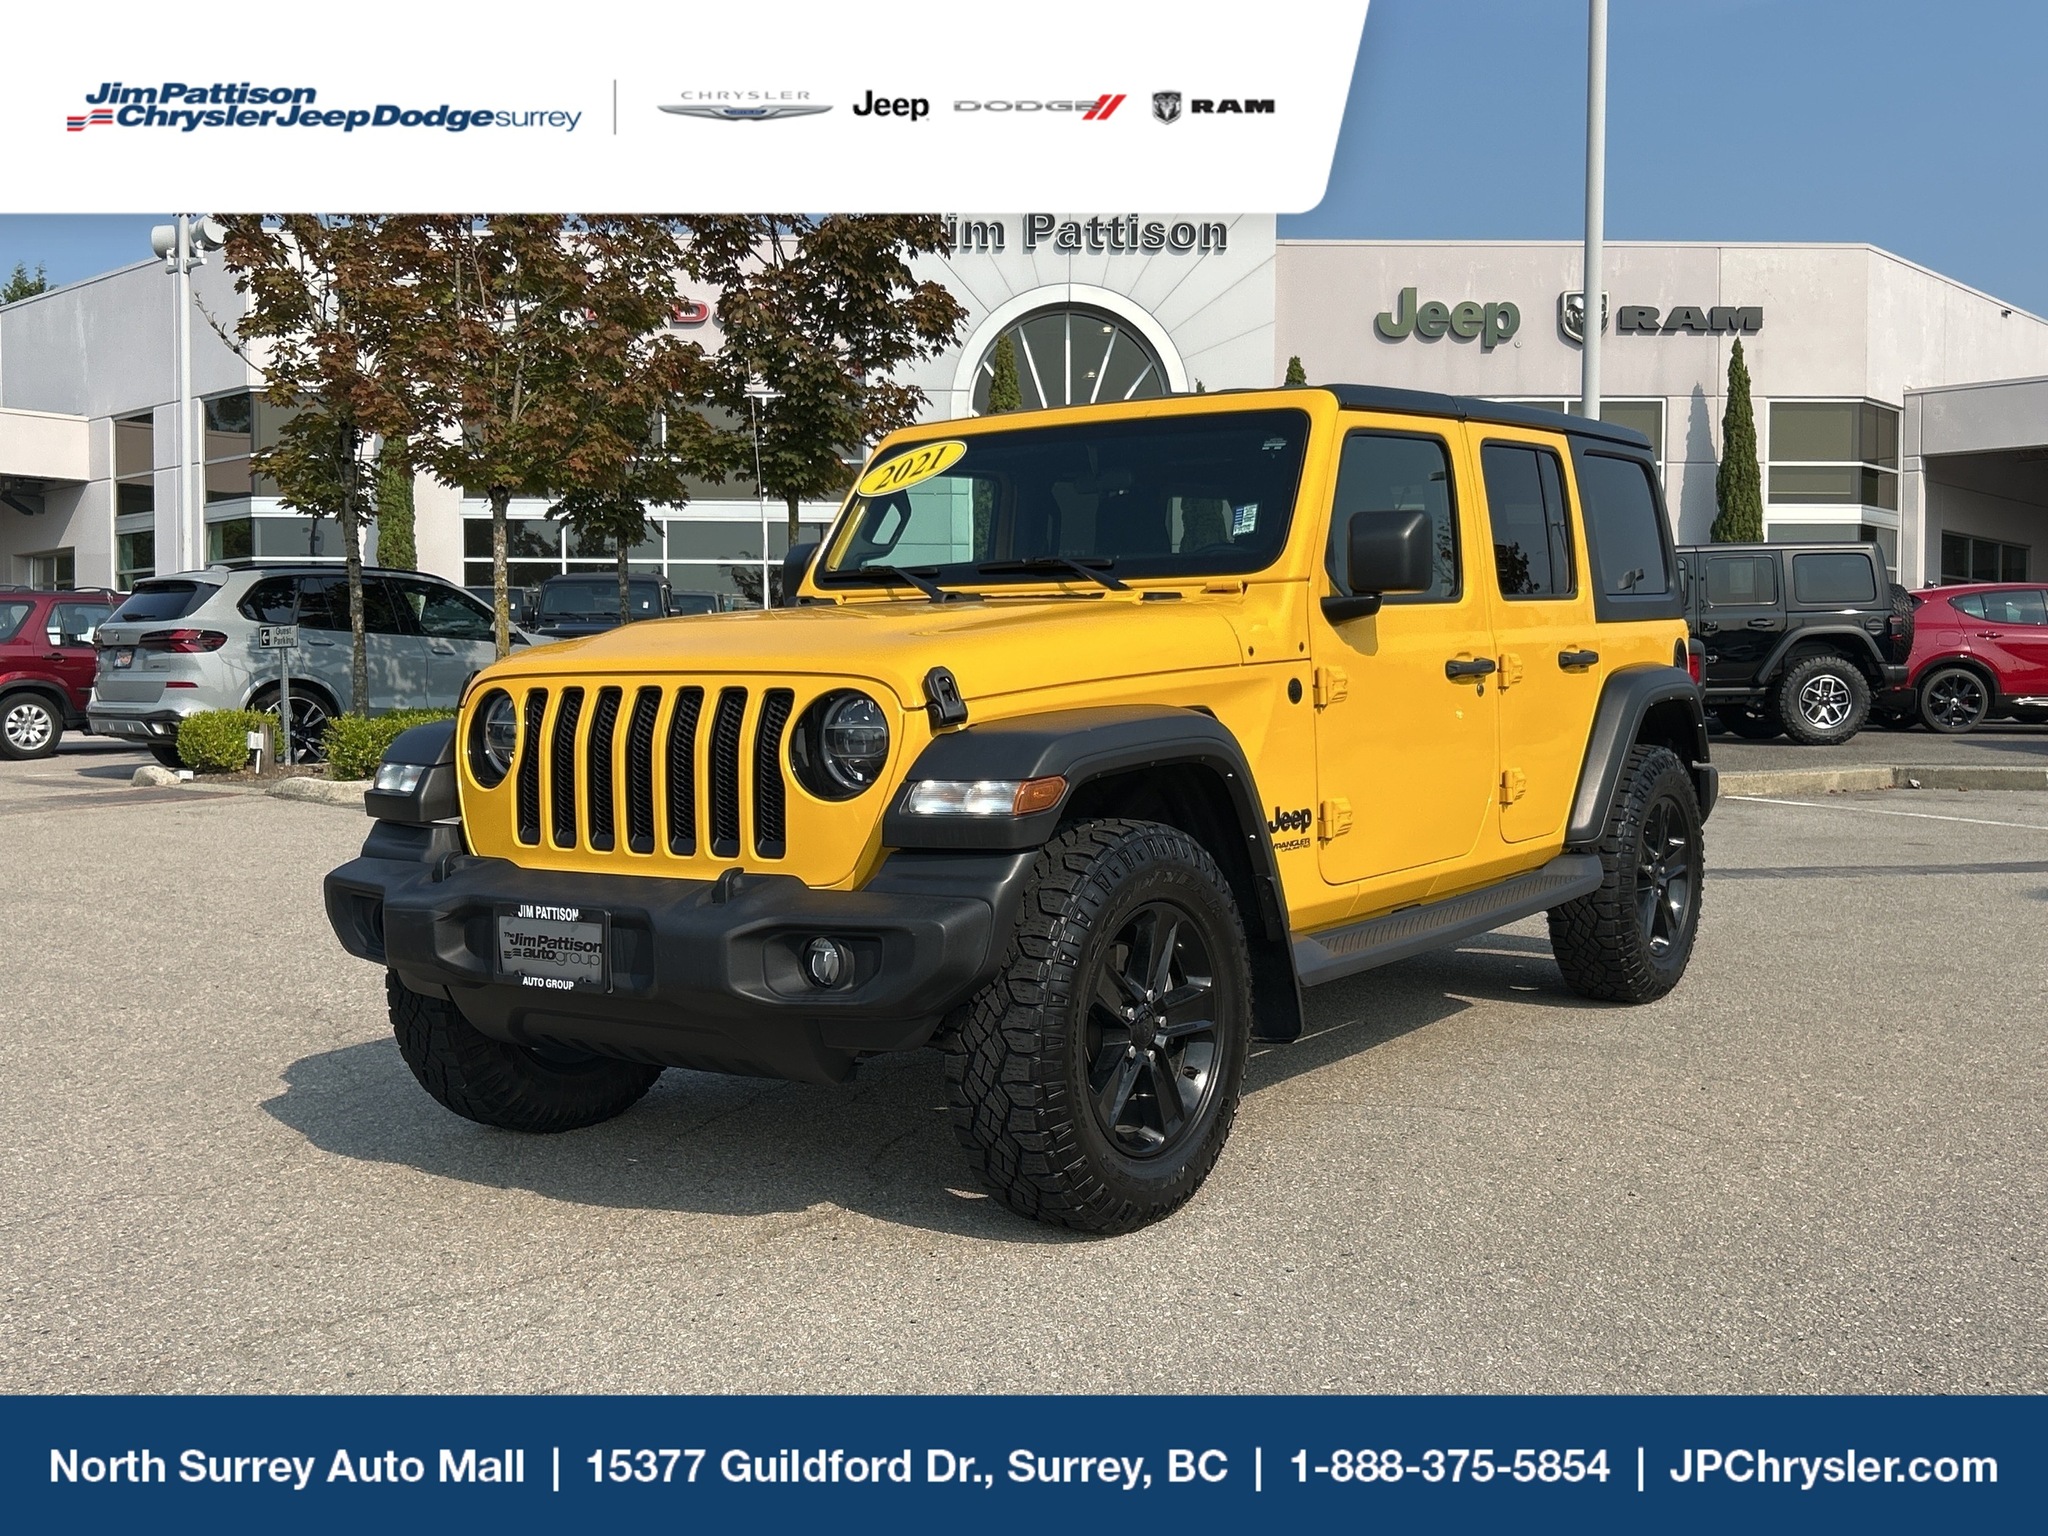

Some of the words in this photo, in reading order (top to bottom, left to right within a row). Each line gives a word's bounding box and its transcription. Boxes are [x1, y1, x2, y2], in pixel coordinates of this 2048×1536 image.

[947, 214, 1005, 248] im
[1026, 214, 1227, 249] Pattison
[1377, 287, 1521, 347] Jeep
[1620, 305, 1763, 331] RAM
[874, 446, 947, 491] 2021
[1268, 806, 1312, 834] Jeep
[518, 904, 534, 918] JIM
[535, 906, 579, 921] PATTISON
[522, 977, 544, 987] AUTO
[545, 978, 574, 990] GROUP
